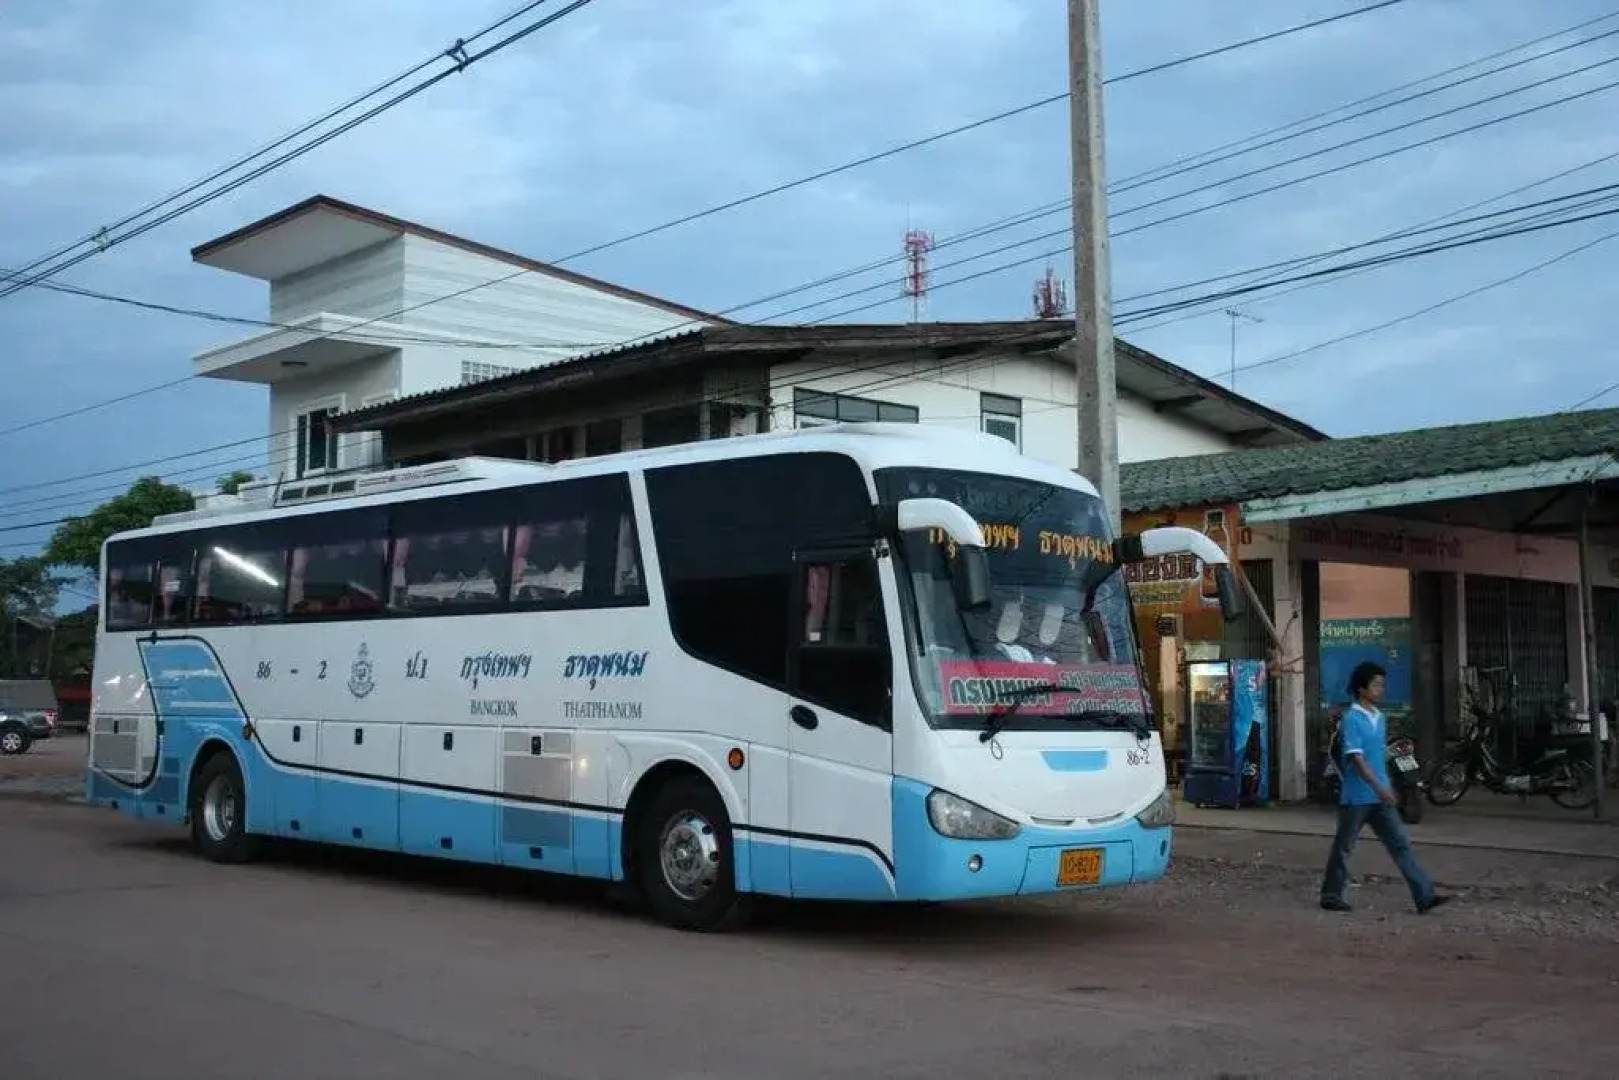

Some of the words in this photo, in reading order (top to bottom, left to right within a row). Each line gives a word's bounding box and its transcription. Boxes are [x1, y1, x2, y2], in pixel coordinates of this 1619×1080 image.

[256, 660, 271, 679] 86
[317, 660, 327, 679] 2
[460, 651, 532, 689] กรุงเทพฯ
[470, 699, 518, 717] BANGKOK
[563, 701, 642, 718] THATPHANOM
